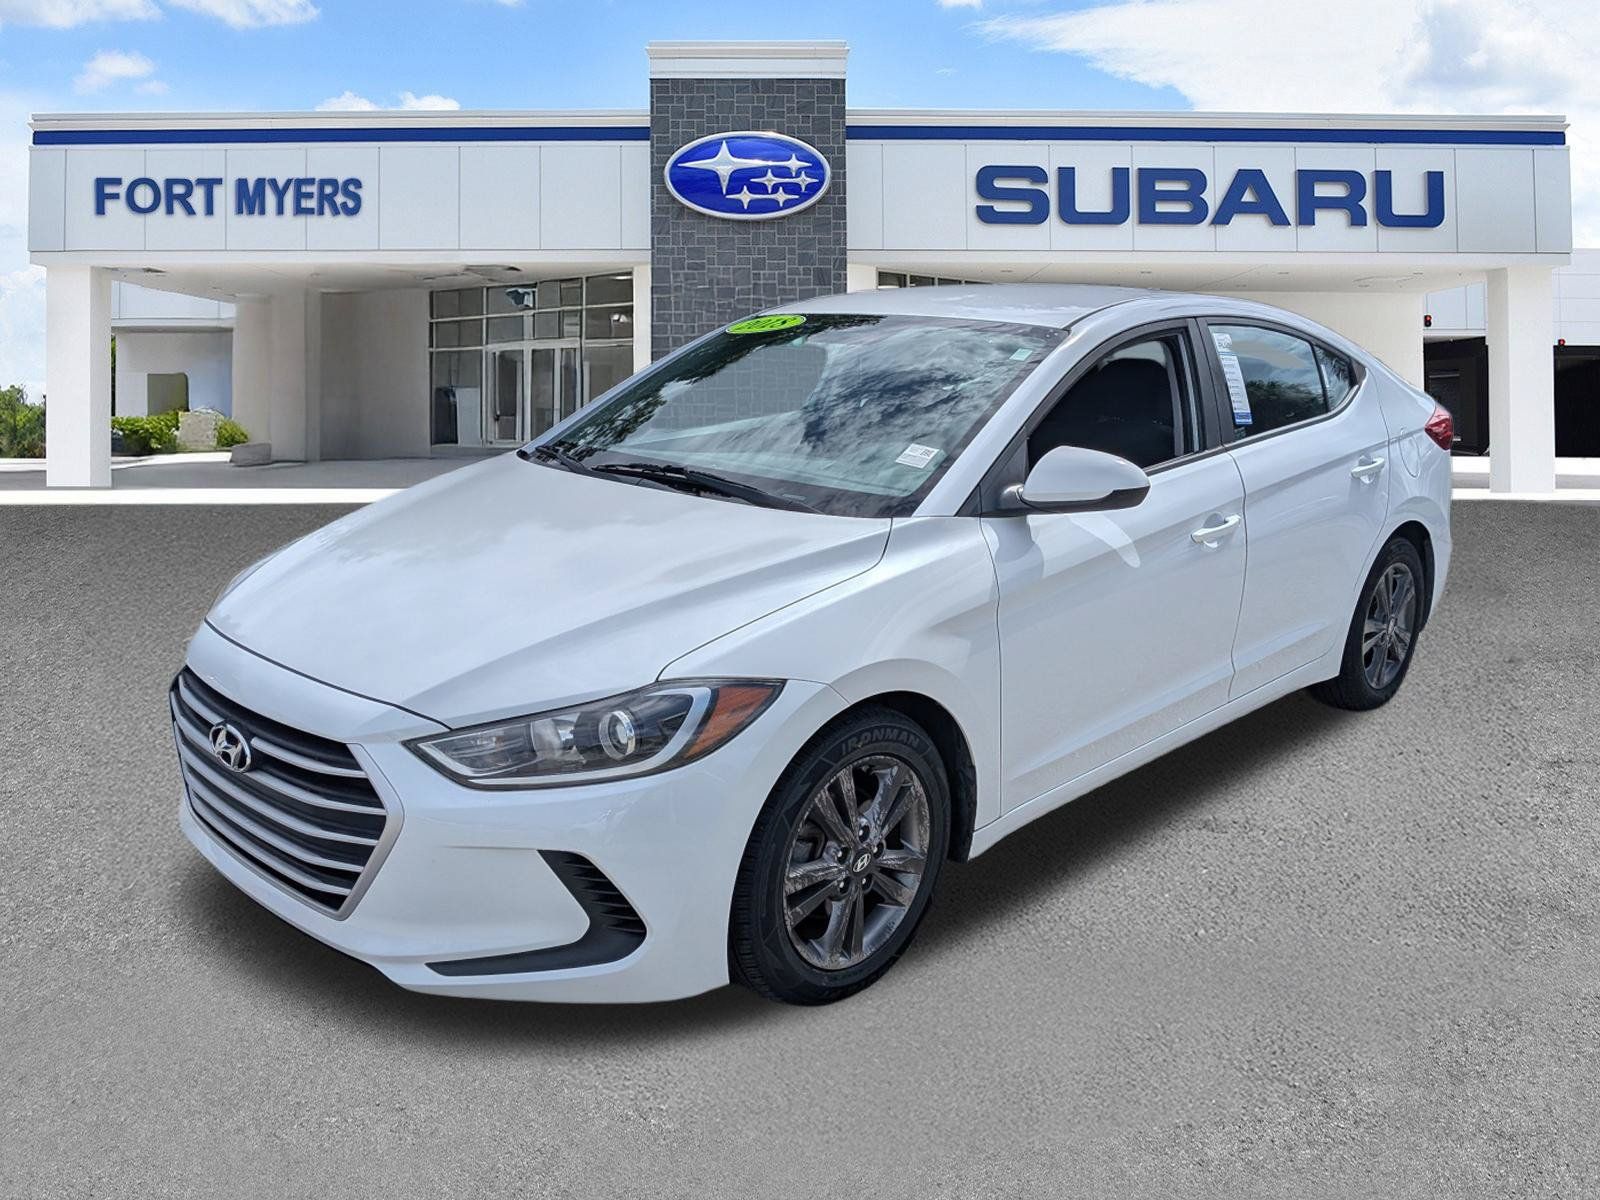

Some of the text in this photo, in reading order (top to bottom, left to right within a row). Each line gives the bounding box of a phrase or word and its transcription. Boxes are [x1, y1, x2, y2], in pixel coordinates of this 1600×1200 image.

[94, 177, 363, 217] FORT MYERS
[975, 165, 1446, 228] SUBARU
[842, 728, 919, 755] IRONMAN
